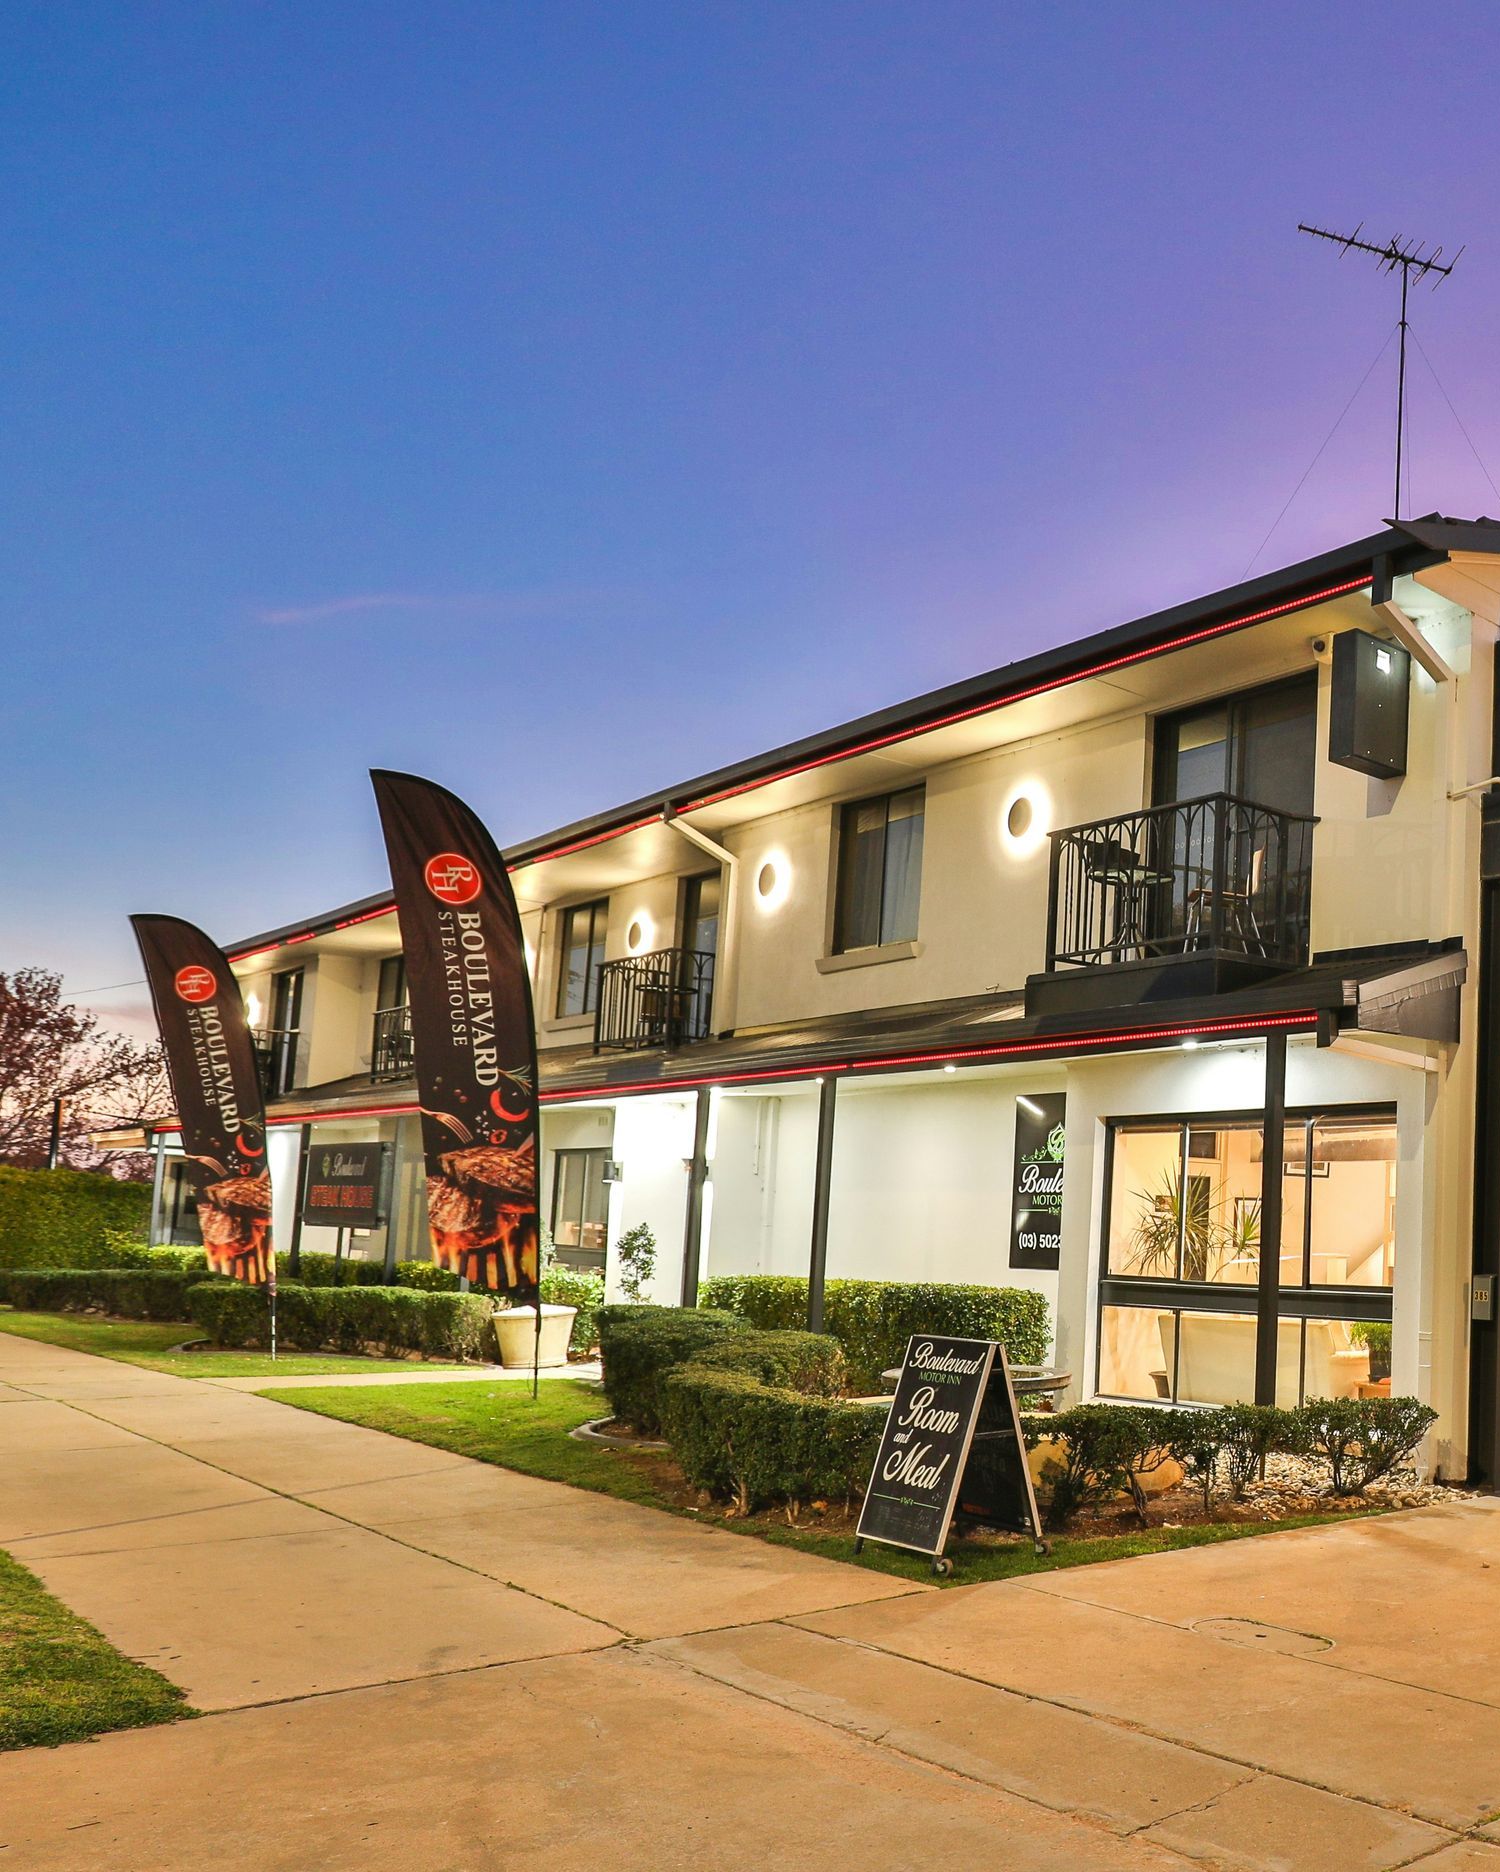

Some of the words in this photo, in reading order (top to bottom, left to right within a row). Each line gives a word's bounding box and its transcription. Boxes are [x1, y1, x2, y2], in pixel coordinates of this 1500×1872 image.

[438, 911, 468, 1047] STEAKHOUSE
[457, 911, 500, 1087] BOULEVARD
[187, 1008, 217, 1107] STEAKHOUSE
[199, 1005, 241, 1134] BOULEVARD
[1032, 1194, 1063, 1206] MOTOR
[1018, 1232, 1037, 1250] (03)
[1474, 1291, 1488, 1301] 385
[909, 1341, 986, 1376] Boulevard
[918, 1371, 947, 1384] MOTOR
[947, 1375, 963, 1386] INN
[898, 1386, 960, 1434] Room
[893, 1428, 914, 1444] and
[883, 1442, 950, 1490] Meal
